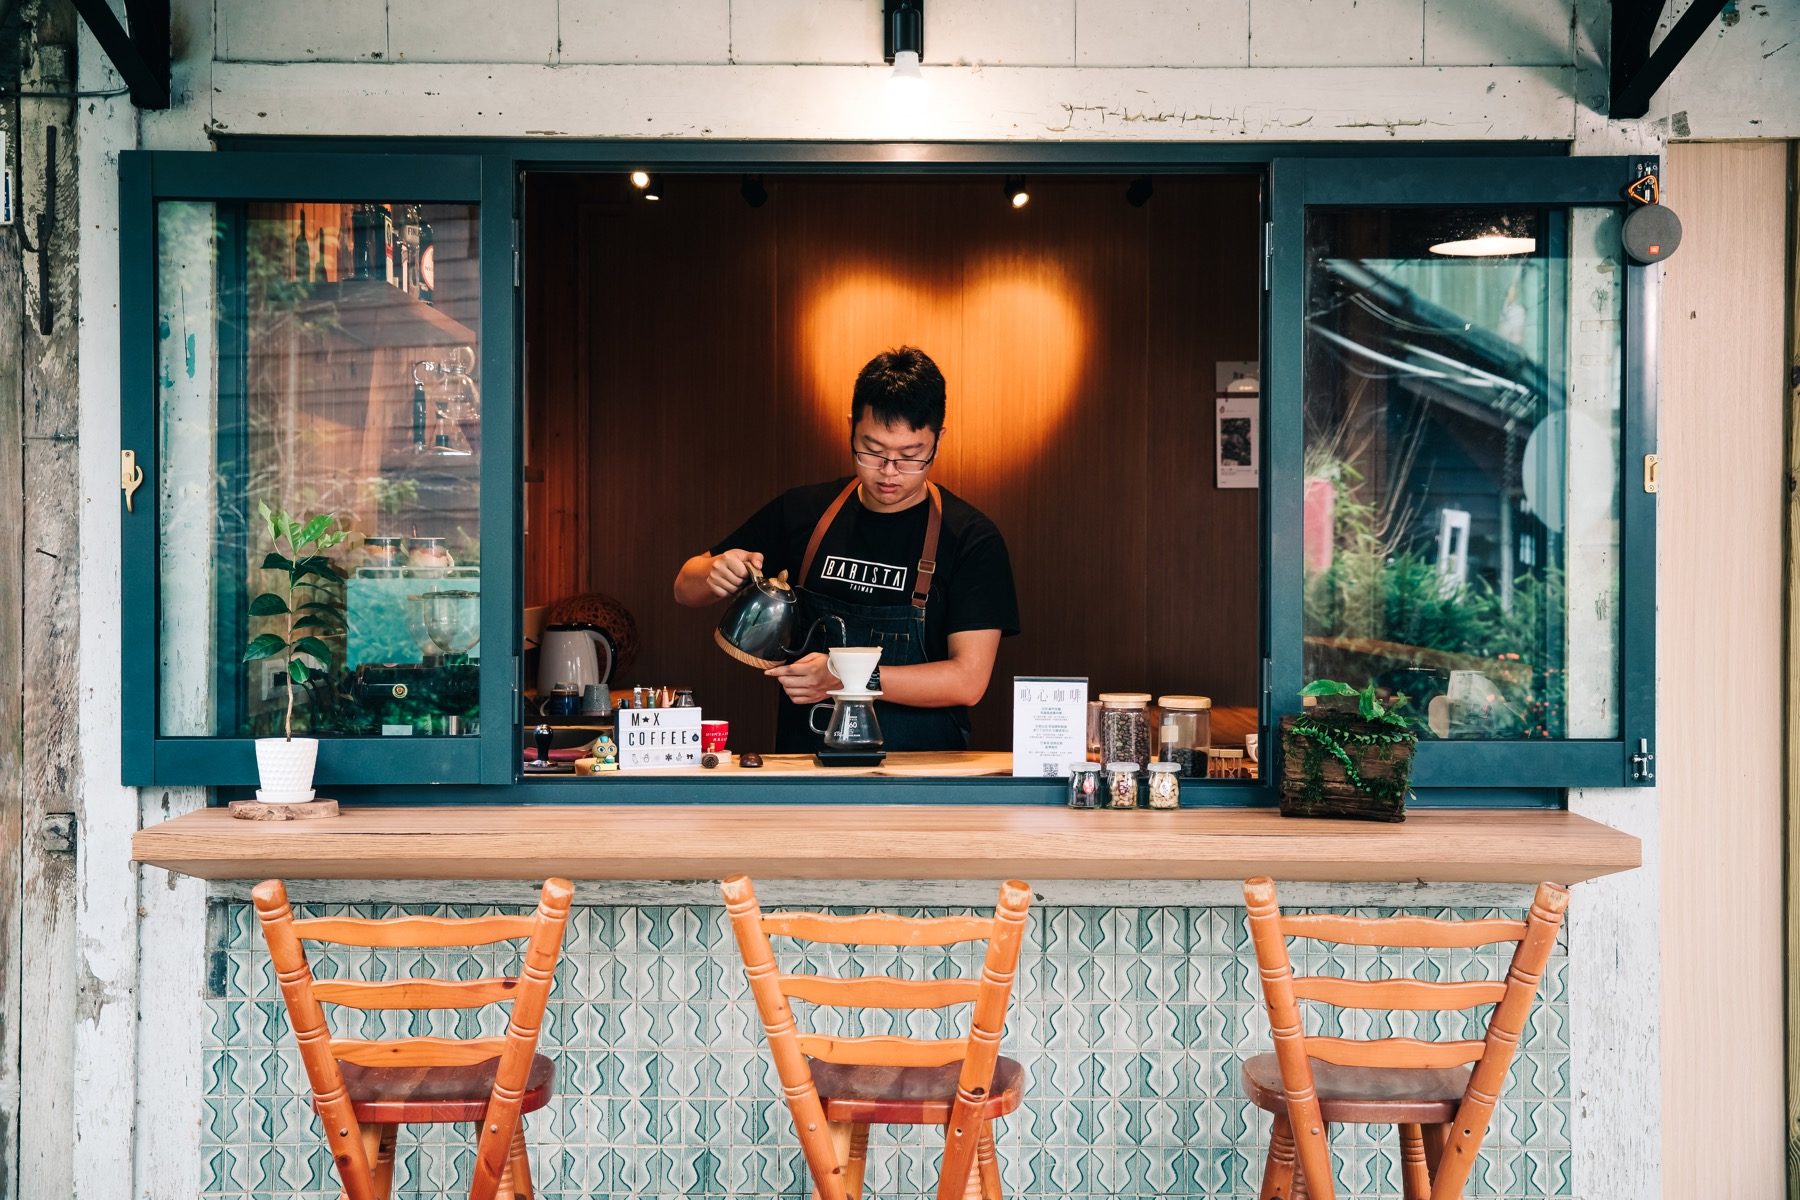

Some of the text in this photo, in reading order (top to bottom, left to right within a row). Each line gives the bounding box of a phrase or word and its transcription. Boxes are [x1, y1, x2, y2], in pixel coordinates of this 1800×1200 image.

[826, 560, 901, 587] BARISTA
[850, 583, 874, 593] TAIWAN
[628, 731, 687, 746] COFFEE
